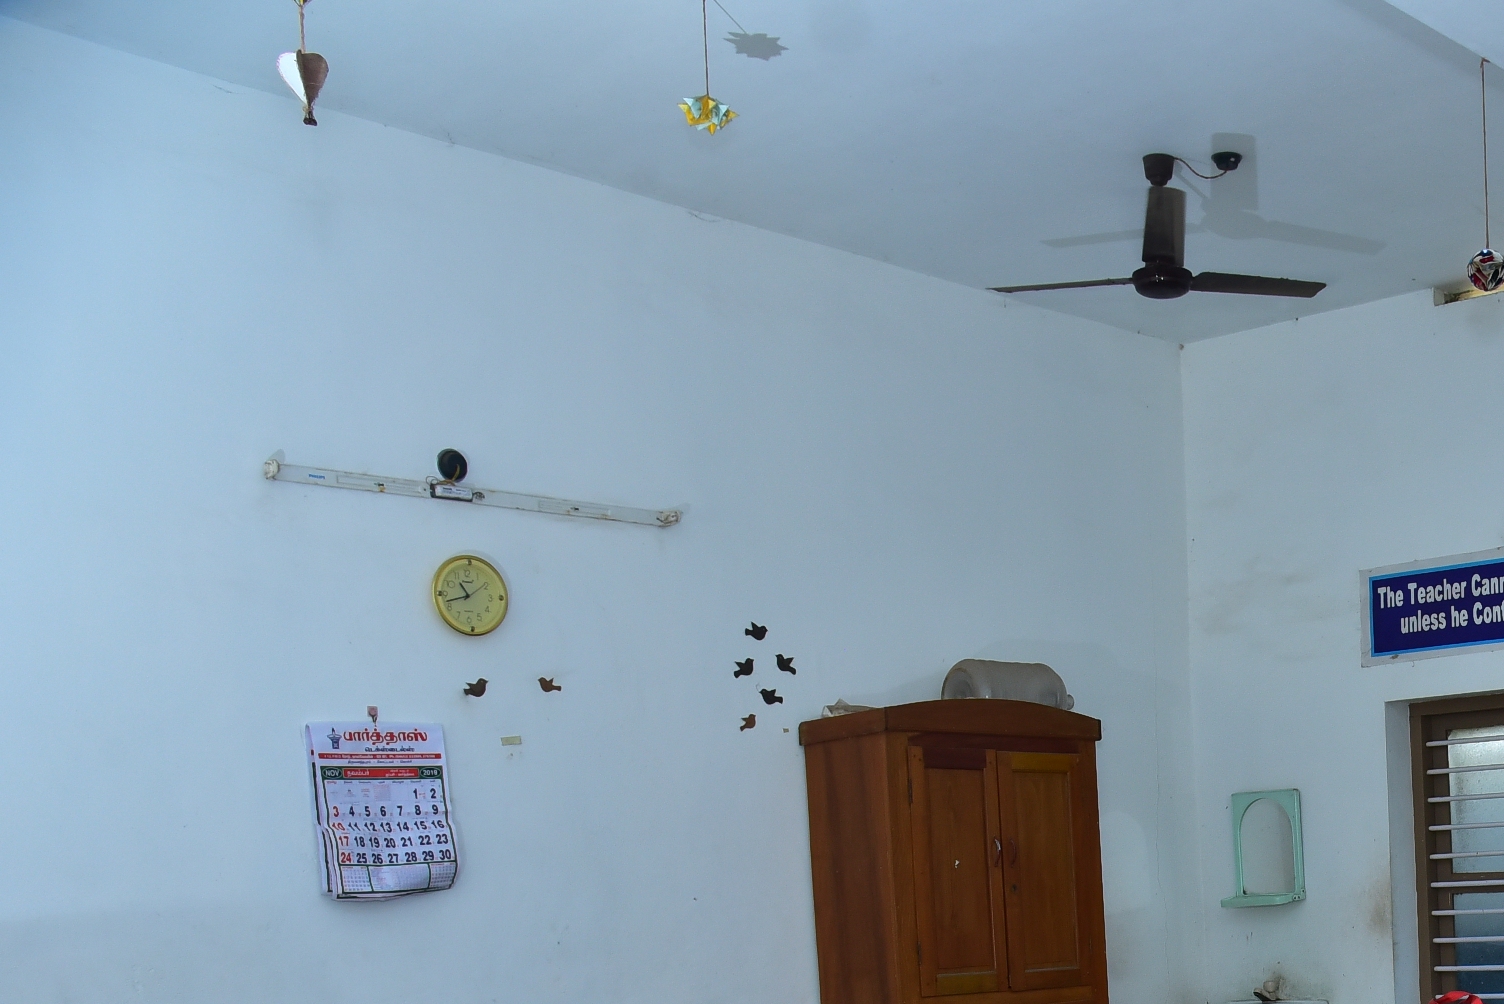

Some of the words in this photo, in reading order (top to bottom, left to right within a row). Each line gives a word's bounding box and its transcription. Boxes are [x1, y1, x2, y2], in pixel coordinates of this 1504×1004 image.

[1378, 587, 1403, 609] The
[1408, 581, 1466, 605] Teacher
[1401, 609, 1446, 634] unless
[1451, 606, 1468, 628] he
[413, 788, 418, 799] 1
[430, 788, 436, 799] 2
[333, 806, 339, 817] 3
[349, 806, 355, 816] 4
[365, 806, 370, 817] 5
[380, 806, 386, 816] 6
[397, 806, 403, 816] 7
[415, 805, 421, 816] 8
[432, 804, 438, 815] 9
[332, 822, 345, 831] 10
[348, 822, 360, 831] 11
[364, 822, 377, 831] 12
[380, 822, 392, 832] 13
[397, 821, 409, 831] 14
[414, 821, 427, 830] 15
[431, 820, 444, 829] 16
[339, 836, 349, 846] 17
[354, 836, 365, 847] 18
[369, 837, 380, 848] 19
[384, 838, 396, 848] 20
[400, 836, 413, 847] 21
[418, 835, 432, 845] 22
[436, 834, 448, 844] 23
[341, 852, 351, 863] 24
[356, 853, 367, 863] 25
[372, 853, 383, 864] 26
[388, 853, 398, 863] 27
[405, 852, 417, 862] 28
[422, 851, 434, 860] 29
[439, 849, 451, 860] 30
